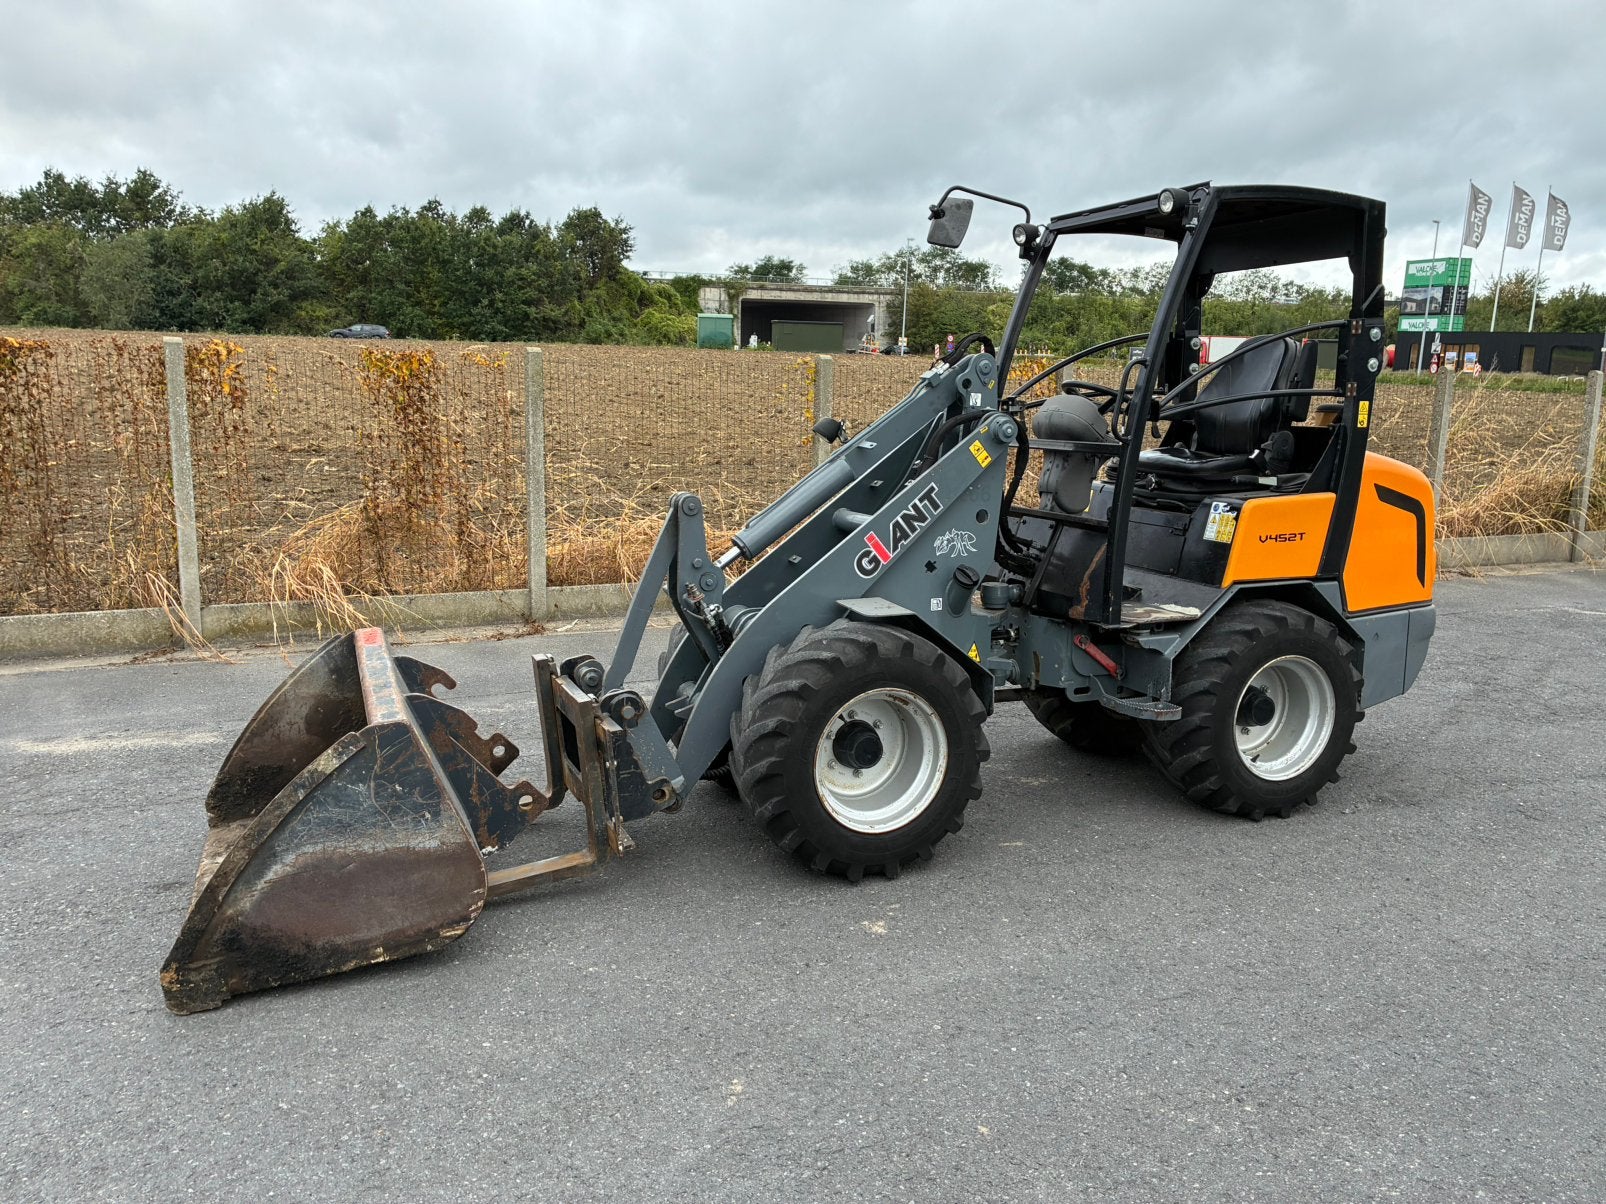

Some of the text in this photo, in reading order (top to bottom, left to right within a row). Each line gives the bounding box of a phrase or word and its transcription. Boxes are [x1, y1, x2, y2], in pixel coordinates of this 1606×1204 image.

[1471, 193, 1489, 243] DEMAN
[1515, 195, 1534, 243] DEMAN
[854, 482, 944, 579] GIANT
[1258, 532, 1306, 543] V452T
